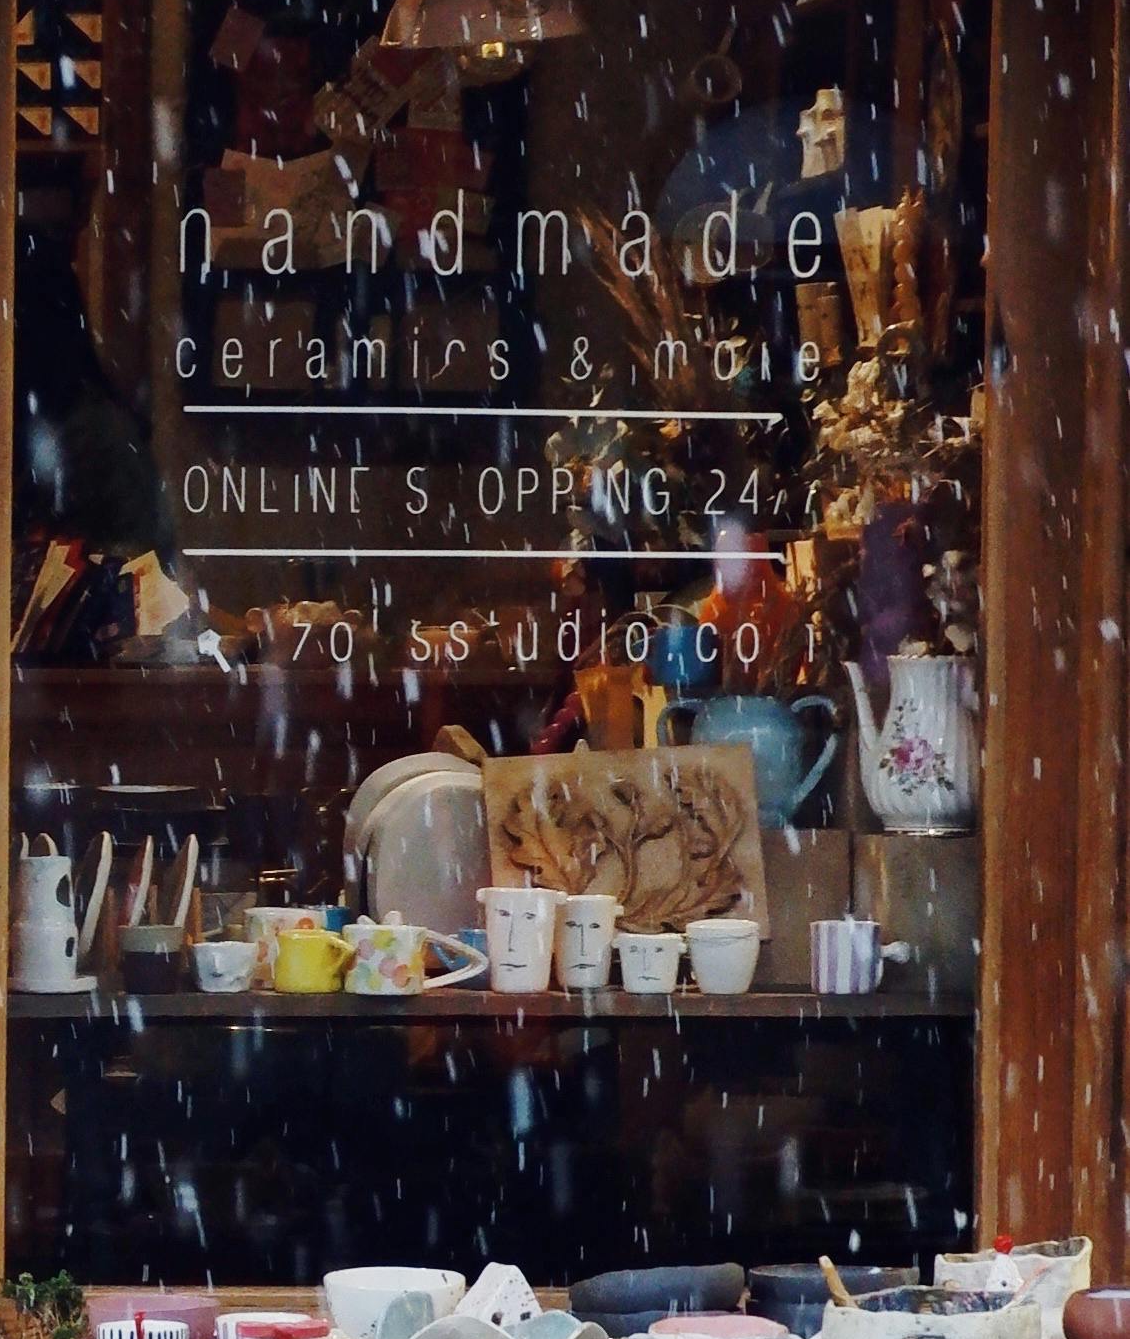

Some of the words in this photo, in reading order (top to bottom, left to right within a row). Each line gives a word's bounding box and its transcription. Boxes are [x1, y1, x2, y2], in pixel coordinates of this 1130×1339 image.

[570, 336, 592, 381] &
[183, 465, 371, 514] ONLINE
[405, 466, 671, 516] SOPPNG
